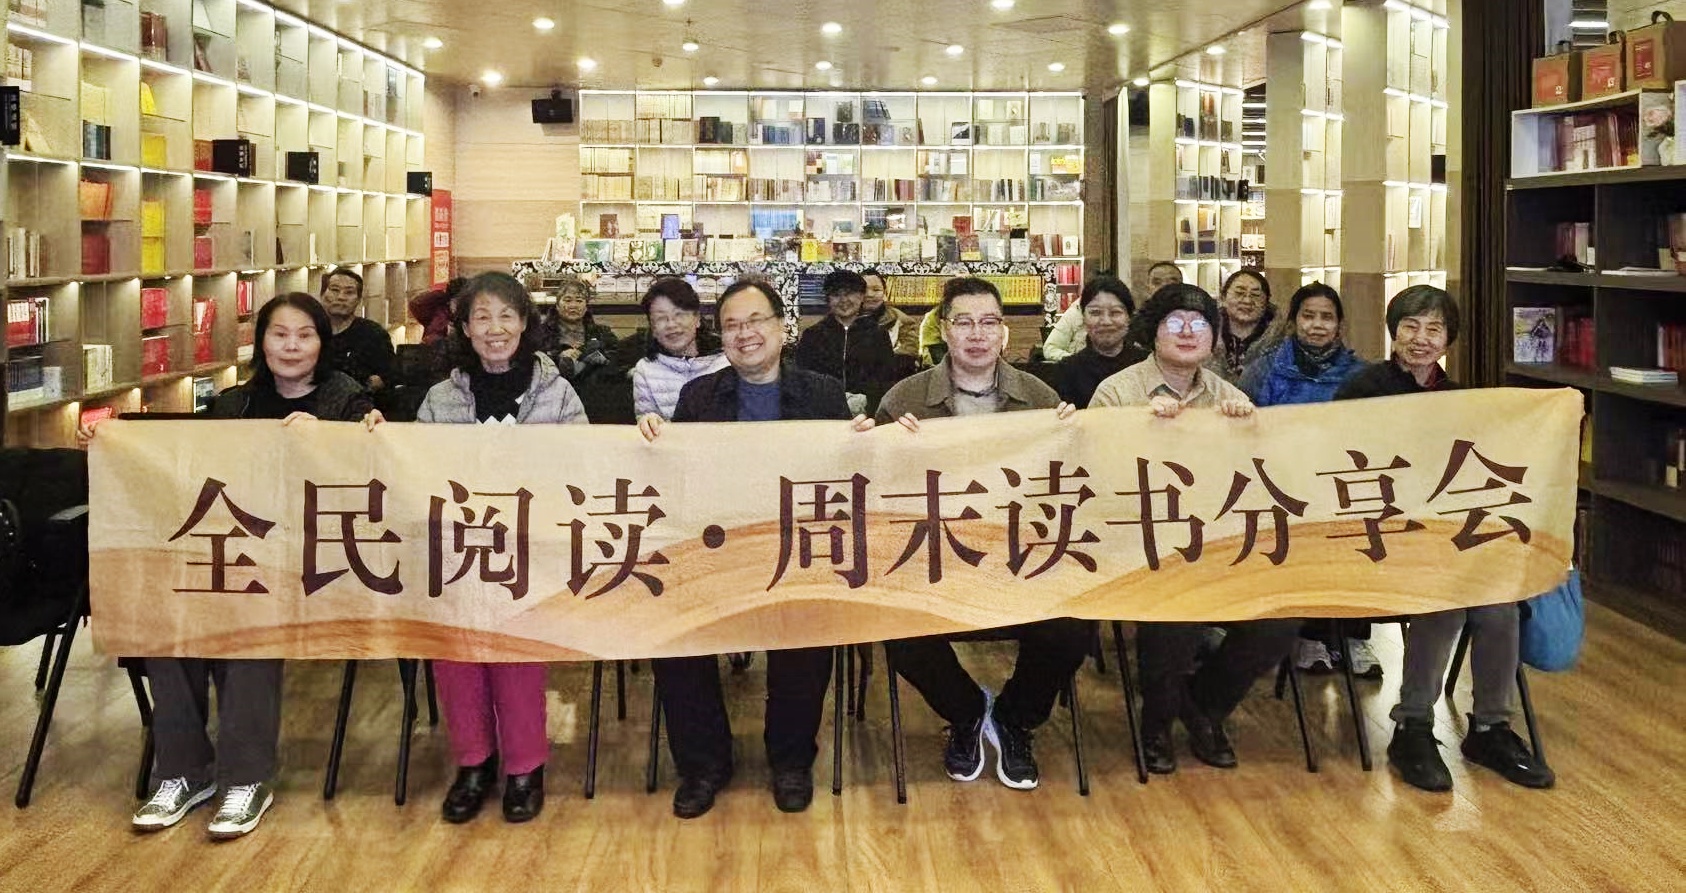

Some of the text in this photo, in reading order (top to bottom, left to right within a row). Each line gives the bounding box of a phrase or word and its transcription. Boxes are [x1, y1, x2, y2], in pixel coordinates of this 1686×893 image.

[168, 440, 1532, 600] 全民阅读·周末读书分享会
